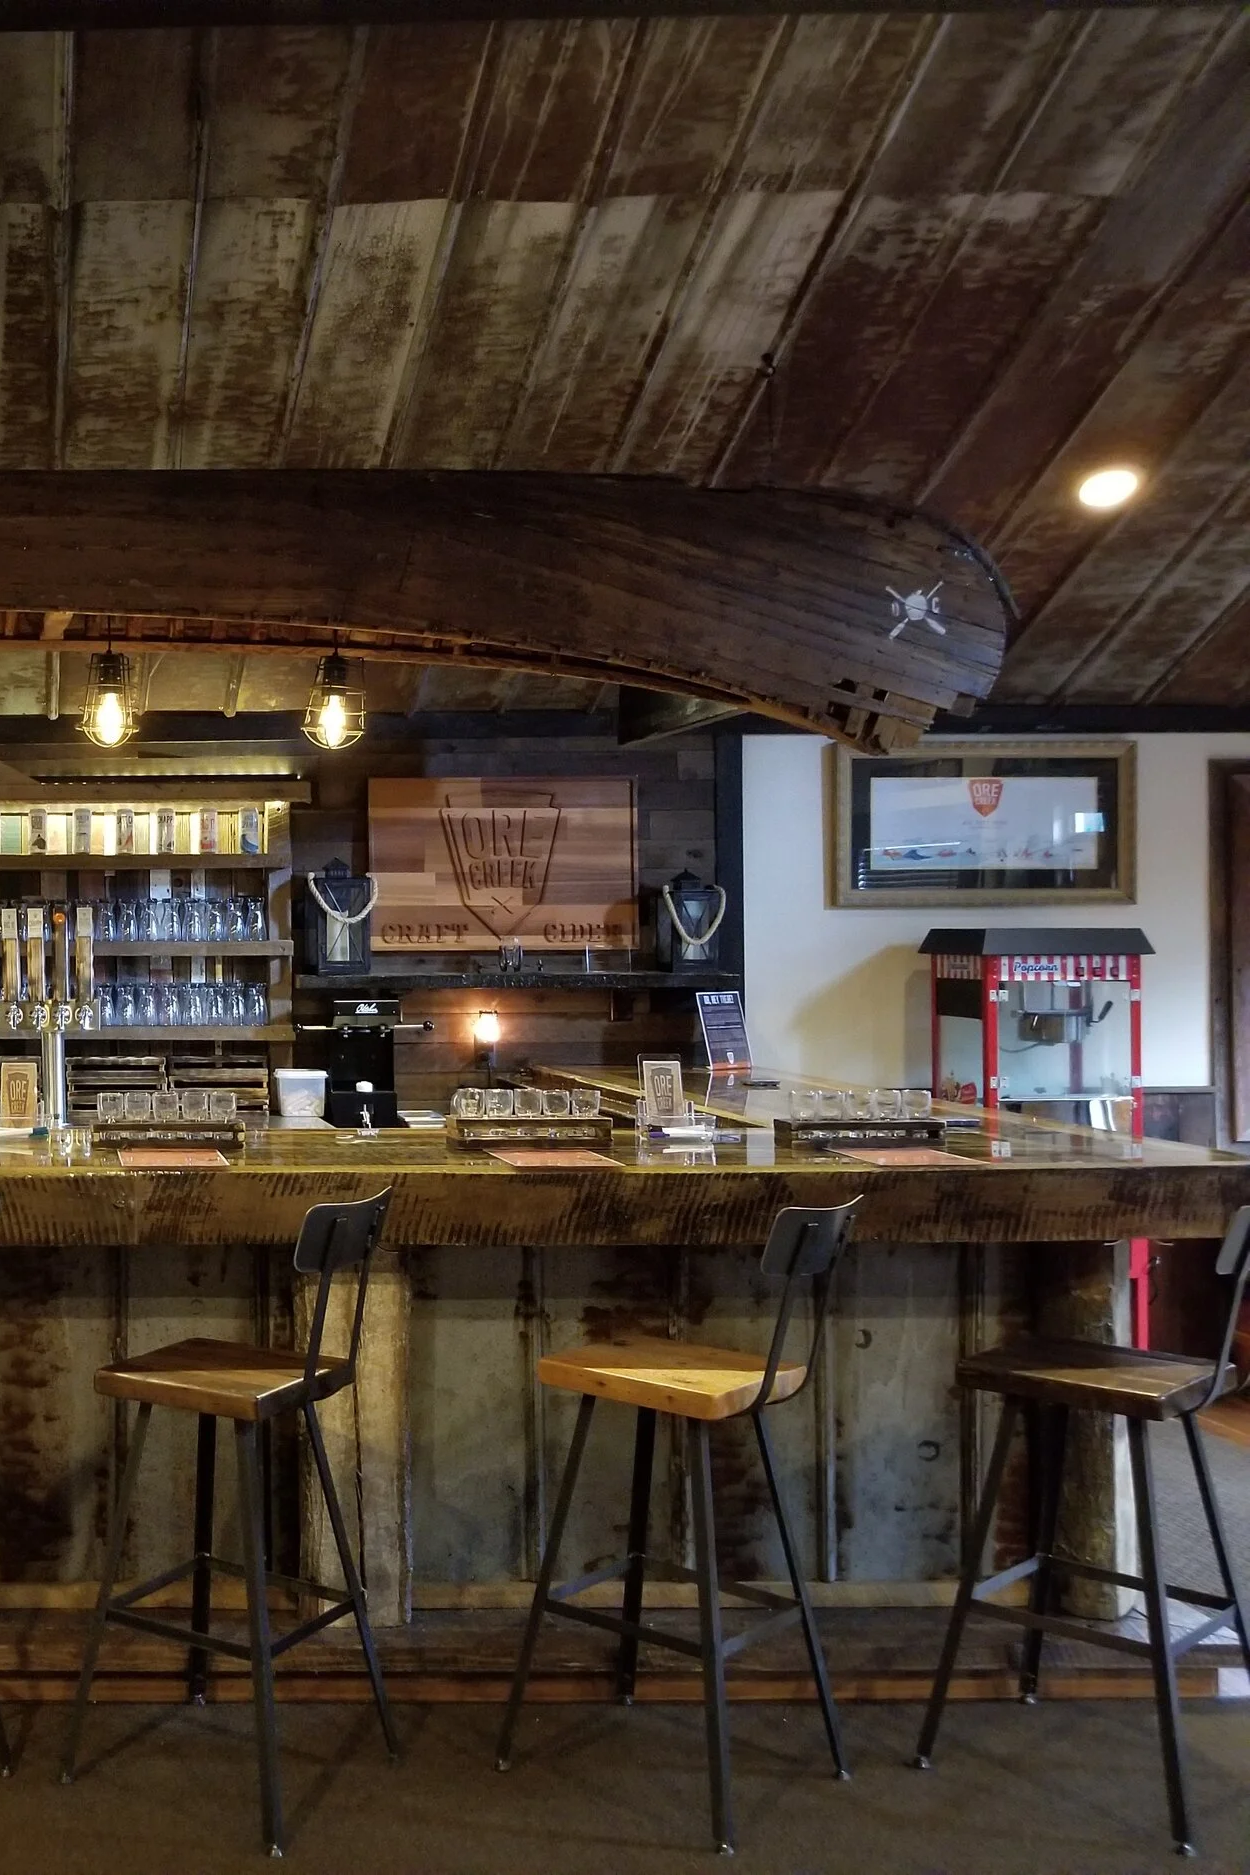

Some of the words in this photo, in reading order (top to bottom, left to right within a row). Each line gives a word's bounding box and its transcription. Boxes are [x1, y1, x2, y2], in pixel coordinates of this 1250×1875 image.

[931, 597, 940, 614] C
[972, 783, 1000, 797] ORE
[461, 809, 546, 859] ORE
[469, 859, 536, 890] CREEK
[381, 922, 470, 944] CRAFT
[544, 922, 625, 943] CIDER
[1013, 962, 1059, 973] Popcorn
[9, 1079, 27, 1101] ORE
[654, 1075, 672, 1097] ORE
